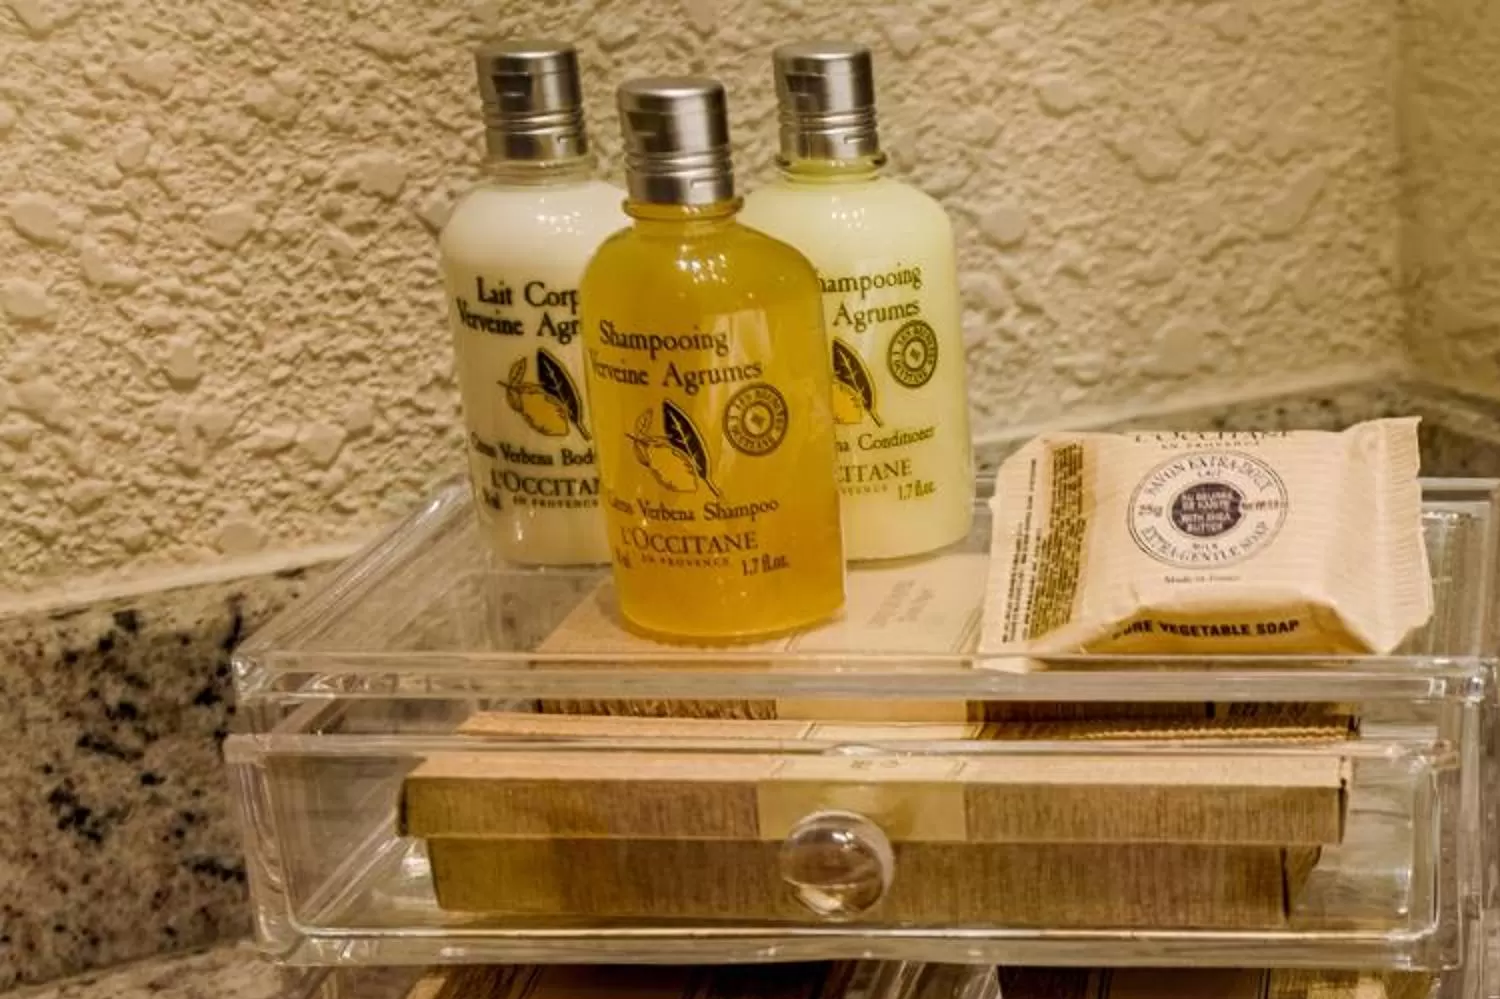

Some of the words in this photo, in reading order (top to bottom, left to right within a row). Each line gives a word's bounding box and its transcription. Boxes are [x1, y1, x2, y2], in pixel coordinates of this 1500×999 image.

[476, 276, 513, 306] Lait
[456, 296, 525, 336] Verveine
[832, 301, 921, 333] Agrumes
[599, 319, 730, 361] Shampooing
[662, 360, 764, 396] Agrumes
[499, 442, 554, 466] Verbena
[636, 496, 696, 522] Verbena
[703, 498, 780, 523] Shampoo
[620, 525, 759, 555] L'OCCITANE
[1156, 620, 1250, 638] VEGETABLE
[1255, 619, 1300, 636] SOAP
